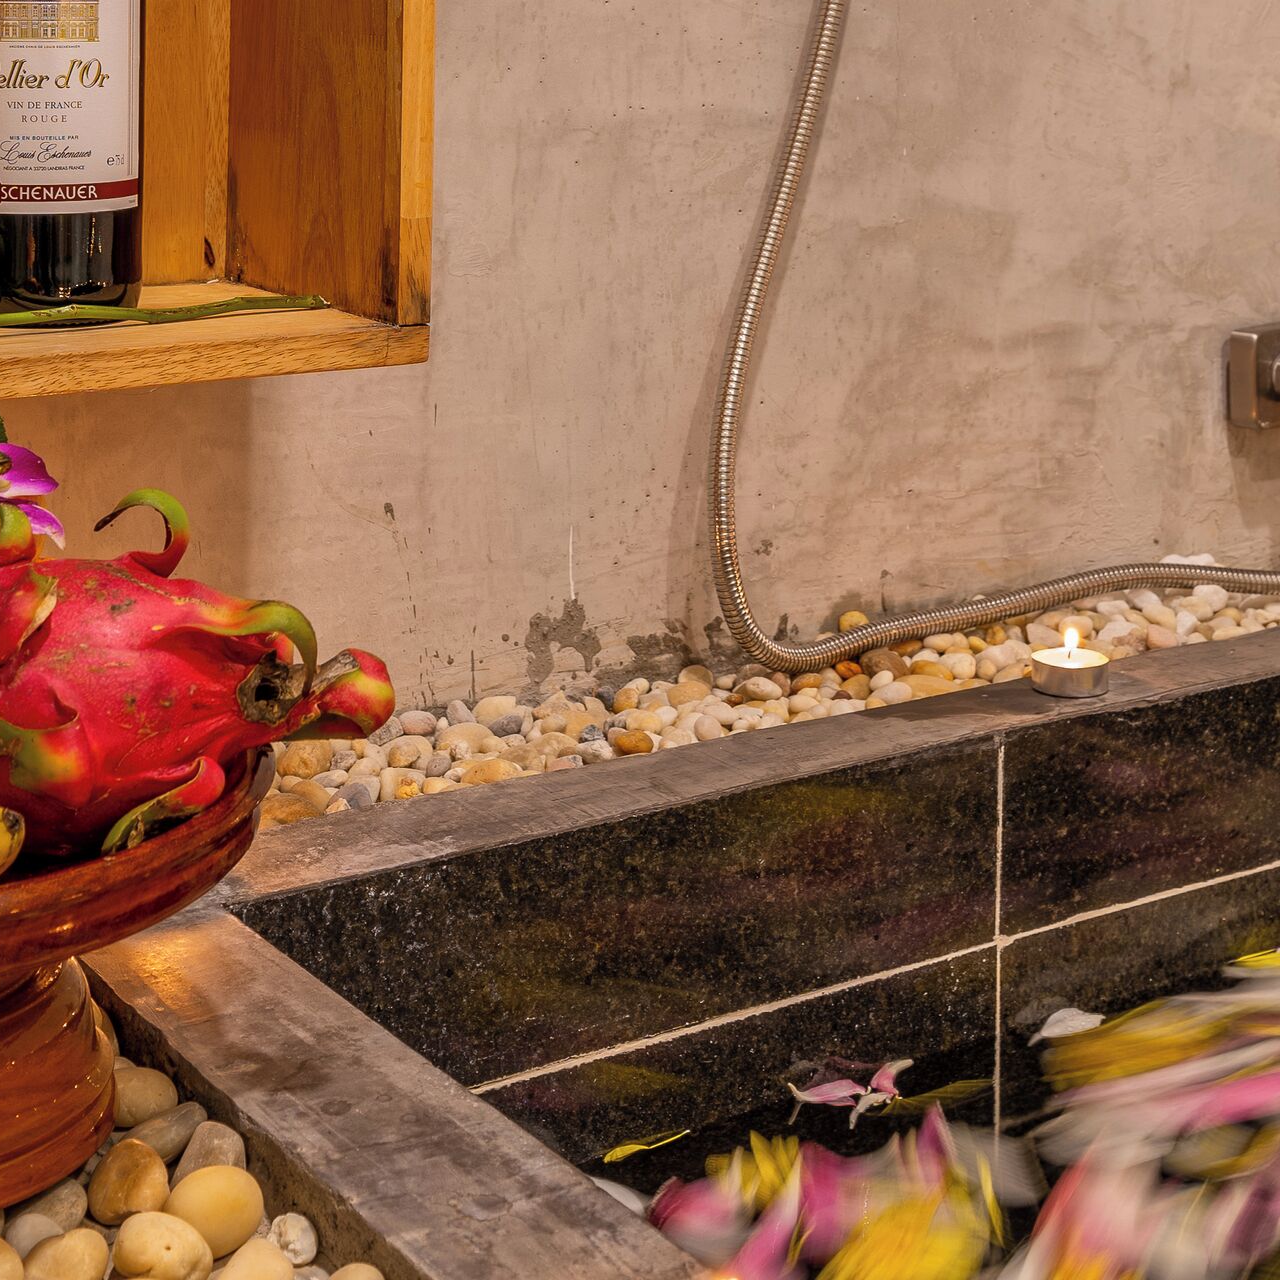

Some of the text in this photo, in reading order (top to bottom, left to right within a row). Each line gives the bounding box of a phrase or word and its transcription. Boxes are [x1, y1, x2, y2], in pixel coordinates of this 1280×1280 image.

[54, 57, 110, 89] d'Or
[6, 100, 83, 109] VIN DE FRANCE
[21, 114, 68, 123] ROUGE
